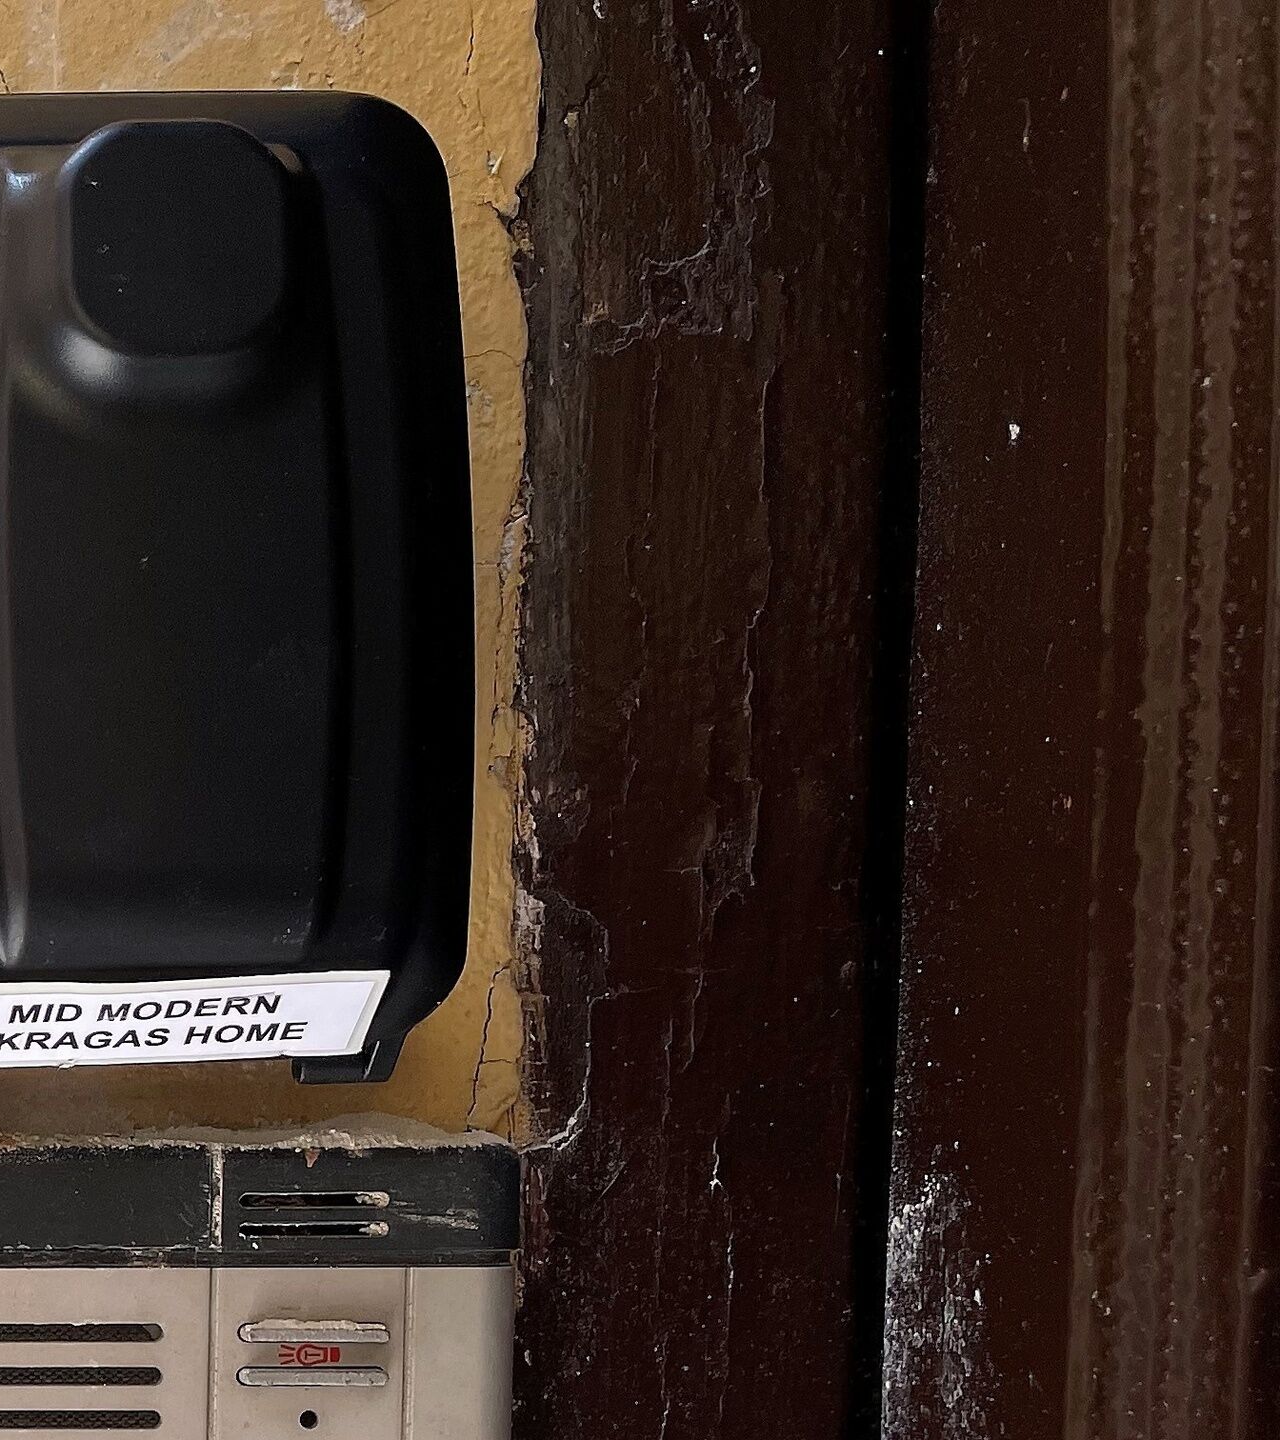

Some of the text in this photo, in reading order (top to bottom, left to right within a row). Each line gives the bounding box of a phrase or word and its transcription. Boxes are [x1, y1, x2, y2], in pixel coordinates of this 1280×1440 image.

[8, 995, 282, 1024] MID MODERN
[184, 1022, 308, 1045] HOME
